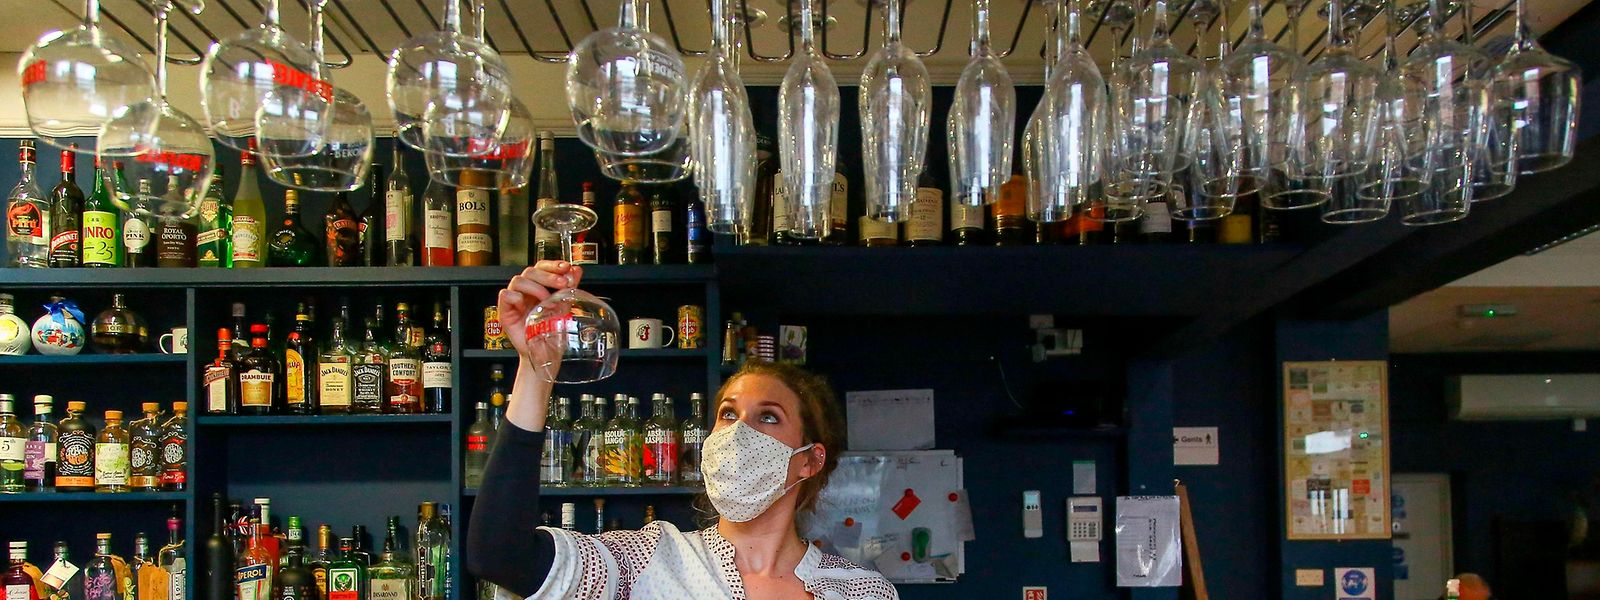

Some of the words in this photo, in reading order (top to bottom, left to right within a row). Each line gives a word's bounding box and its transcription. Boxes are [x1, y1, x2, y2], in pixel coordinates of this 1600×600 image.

[459, 201, 487, 212] BOLS
[83, 226, 115, 240] INRO
[163, 227, 184, 235] ROYAL
[161, 233, 187, 241] OPORTO
[487, 327, 501, 335] Club
